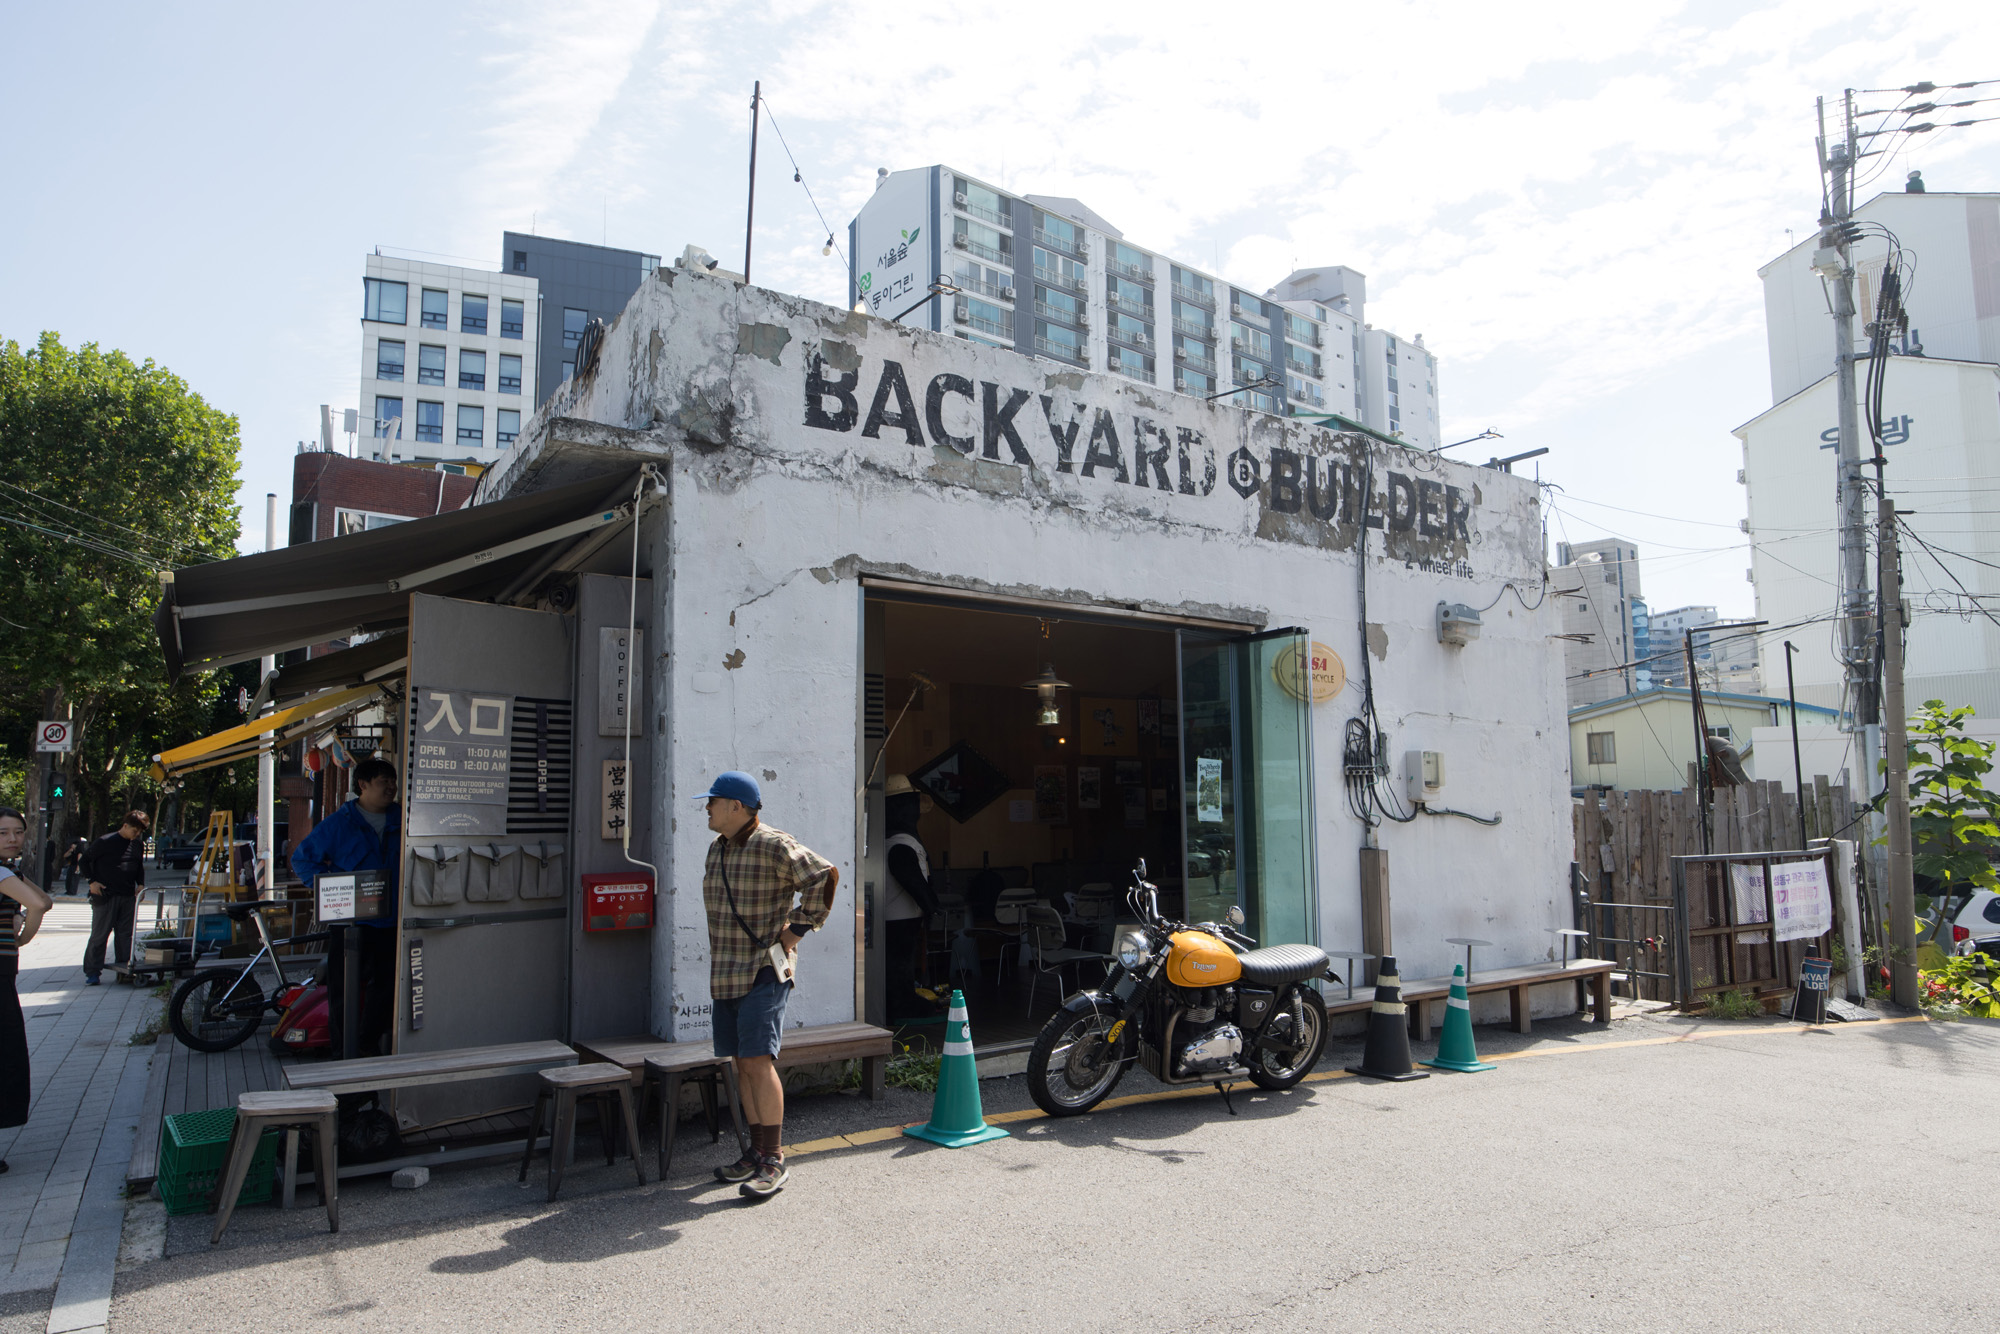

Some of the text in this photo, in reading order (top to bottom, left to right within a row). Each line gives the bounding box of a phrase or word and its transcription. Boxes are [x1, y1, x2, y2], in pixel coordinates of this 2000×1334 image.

[877, 242, 908, 269] 서울숲
[872, 273, 914, 310] 동아그린
[802, 352, 1217, 497] BACKYARD
[1271, 447, 1471, 544] BUILDER
[1404, 551, 1414, 570] 2
[1456, 560, 1474, 580] life
[617, 637, 626, 716] COFFEE
[423, 692, 506, 736] 入口
[48, 728, 61, 739] 30
[341, 738, 381, 751] TERRA
[418, 758, 506, 771] CLOSED 12:00 AM
[419, 744, 507, 759] OPEN 11:00 AM
[426, 779, 458, 787] RESTROOM
[459, 780, 486, 788] OUTDOOR
[538, 759, 547, 793] OPEN
[609, 894, 645, 903] POST
[410, 947, 423, 1020] ONLY PULL
[680, 1003, 712, 1018] 사다리
